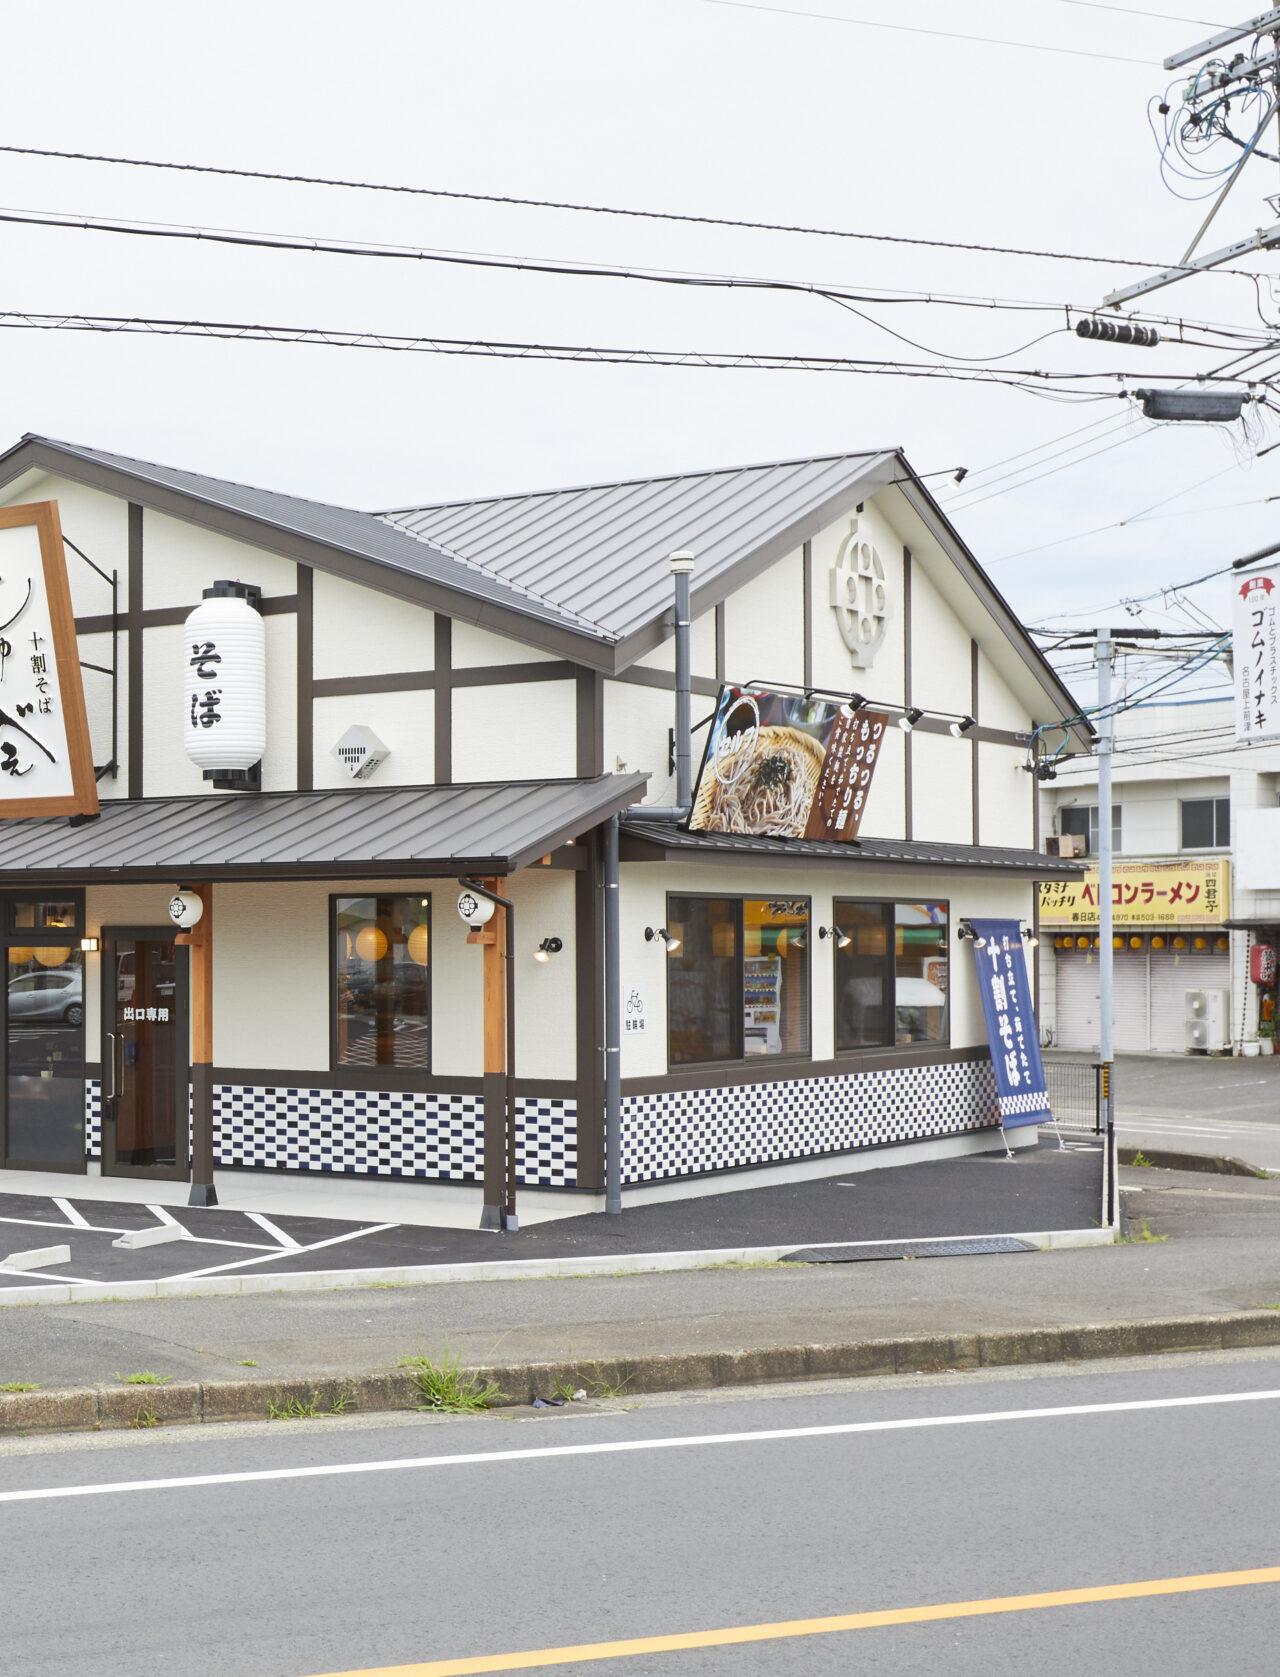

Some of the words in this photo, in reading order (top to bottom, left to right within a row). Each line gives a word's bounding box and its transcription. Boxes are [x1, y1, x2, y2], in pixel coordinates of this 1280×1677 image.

[27, 631, 53, 715] 十割そば
[189, 641, 223, 729] そば
[1251, 606, 1268, 729] ゴムノイナキ
[834, 719, 870, 830] もっちり麺
[1072, 912, 1096, 922] 春日店
[1205, 878, 1218, 913] 四君子
[123, 1006, 169, 1022] 出口専用
[987, 936, 1021, 1087] 十割そば
